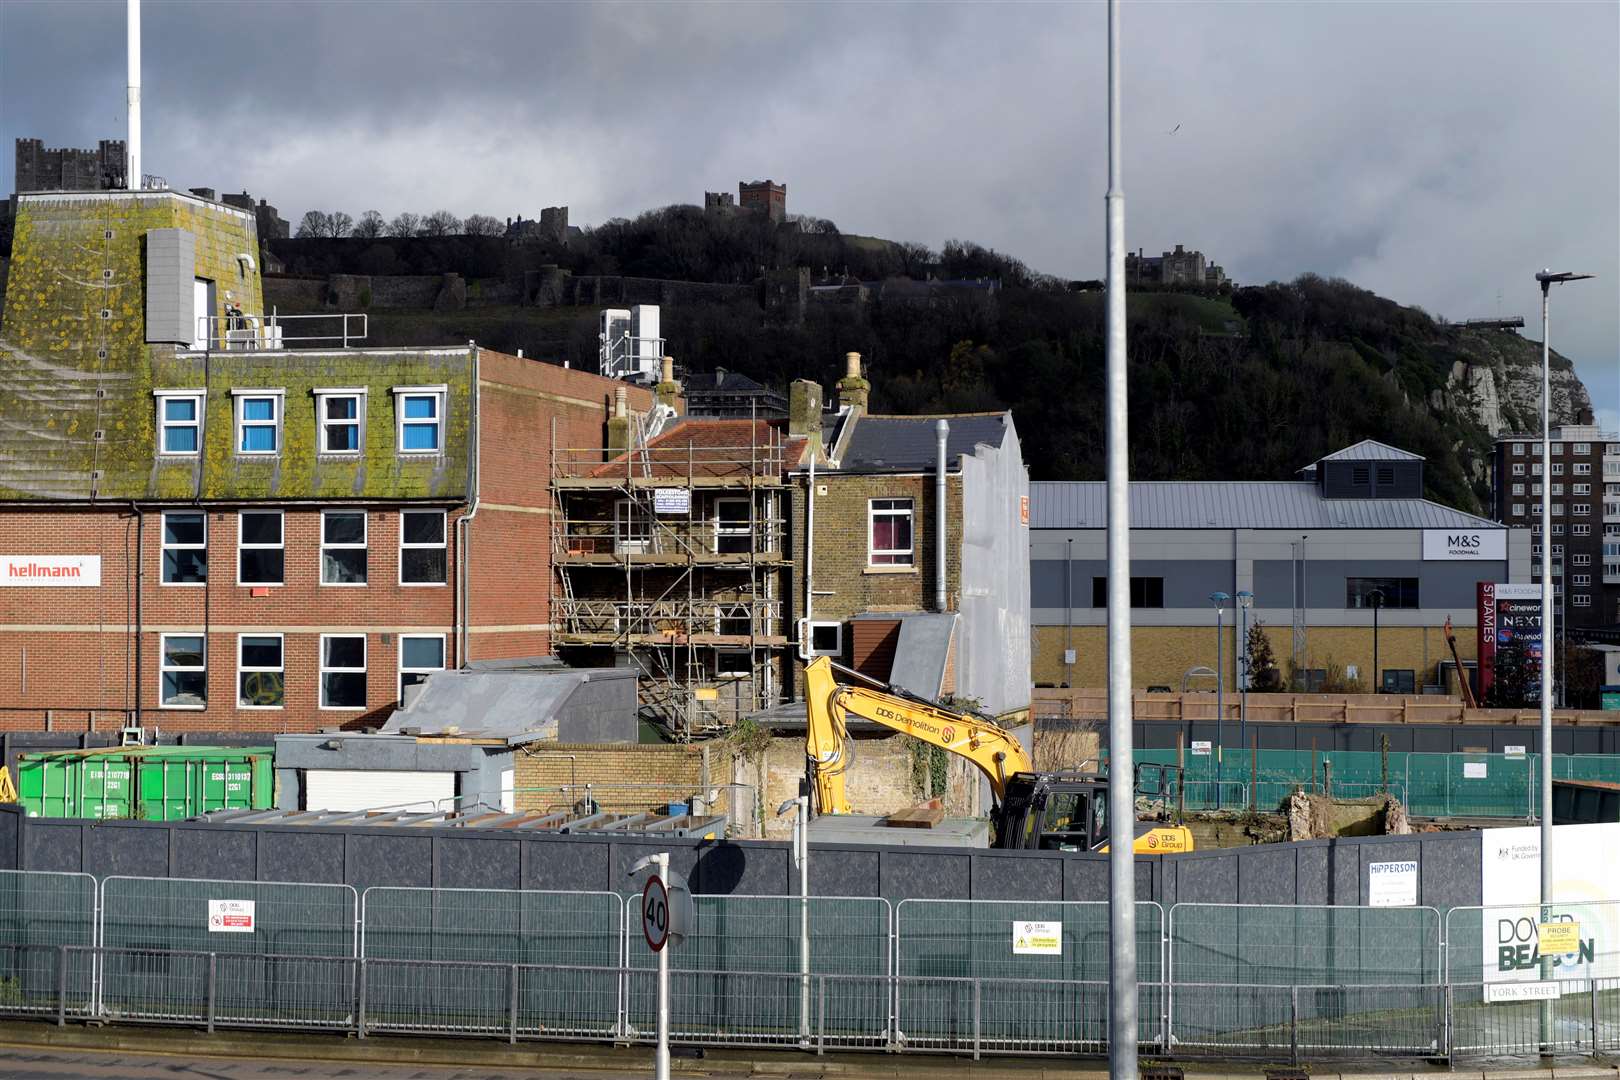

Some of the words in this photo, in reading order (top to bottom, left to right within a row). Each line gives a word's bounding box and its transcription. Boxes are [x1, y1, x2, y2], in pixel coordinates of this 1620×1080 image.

[1448, 535, 1480, 548] M&S
[9, 563, 80, 577] hellmann
[1483, 585, 1494, 597] ST
[1509, 604, 1541, 612] cinewor
[1483, 600, 1494, 643] JAMES
[1503, 616, 1542, 627] NEXT
[876, 707, 894, 720] DDS
[895, 713, 939, 735] Demolition
[1512, 845, 1530, 853] Funded
[1532, 844, 1539, 852] by
[646, 897, 666, 932] 40
[1547, 927, 1572, 935] PROBE
[1492, 987, 1518, 998] YORK
[1522, 986, 1556, 997] STREET
